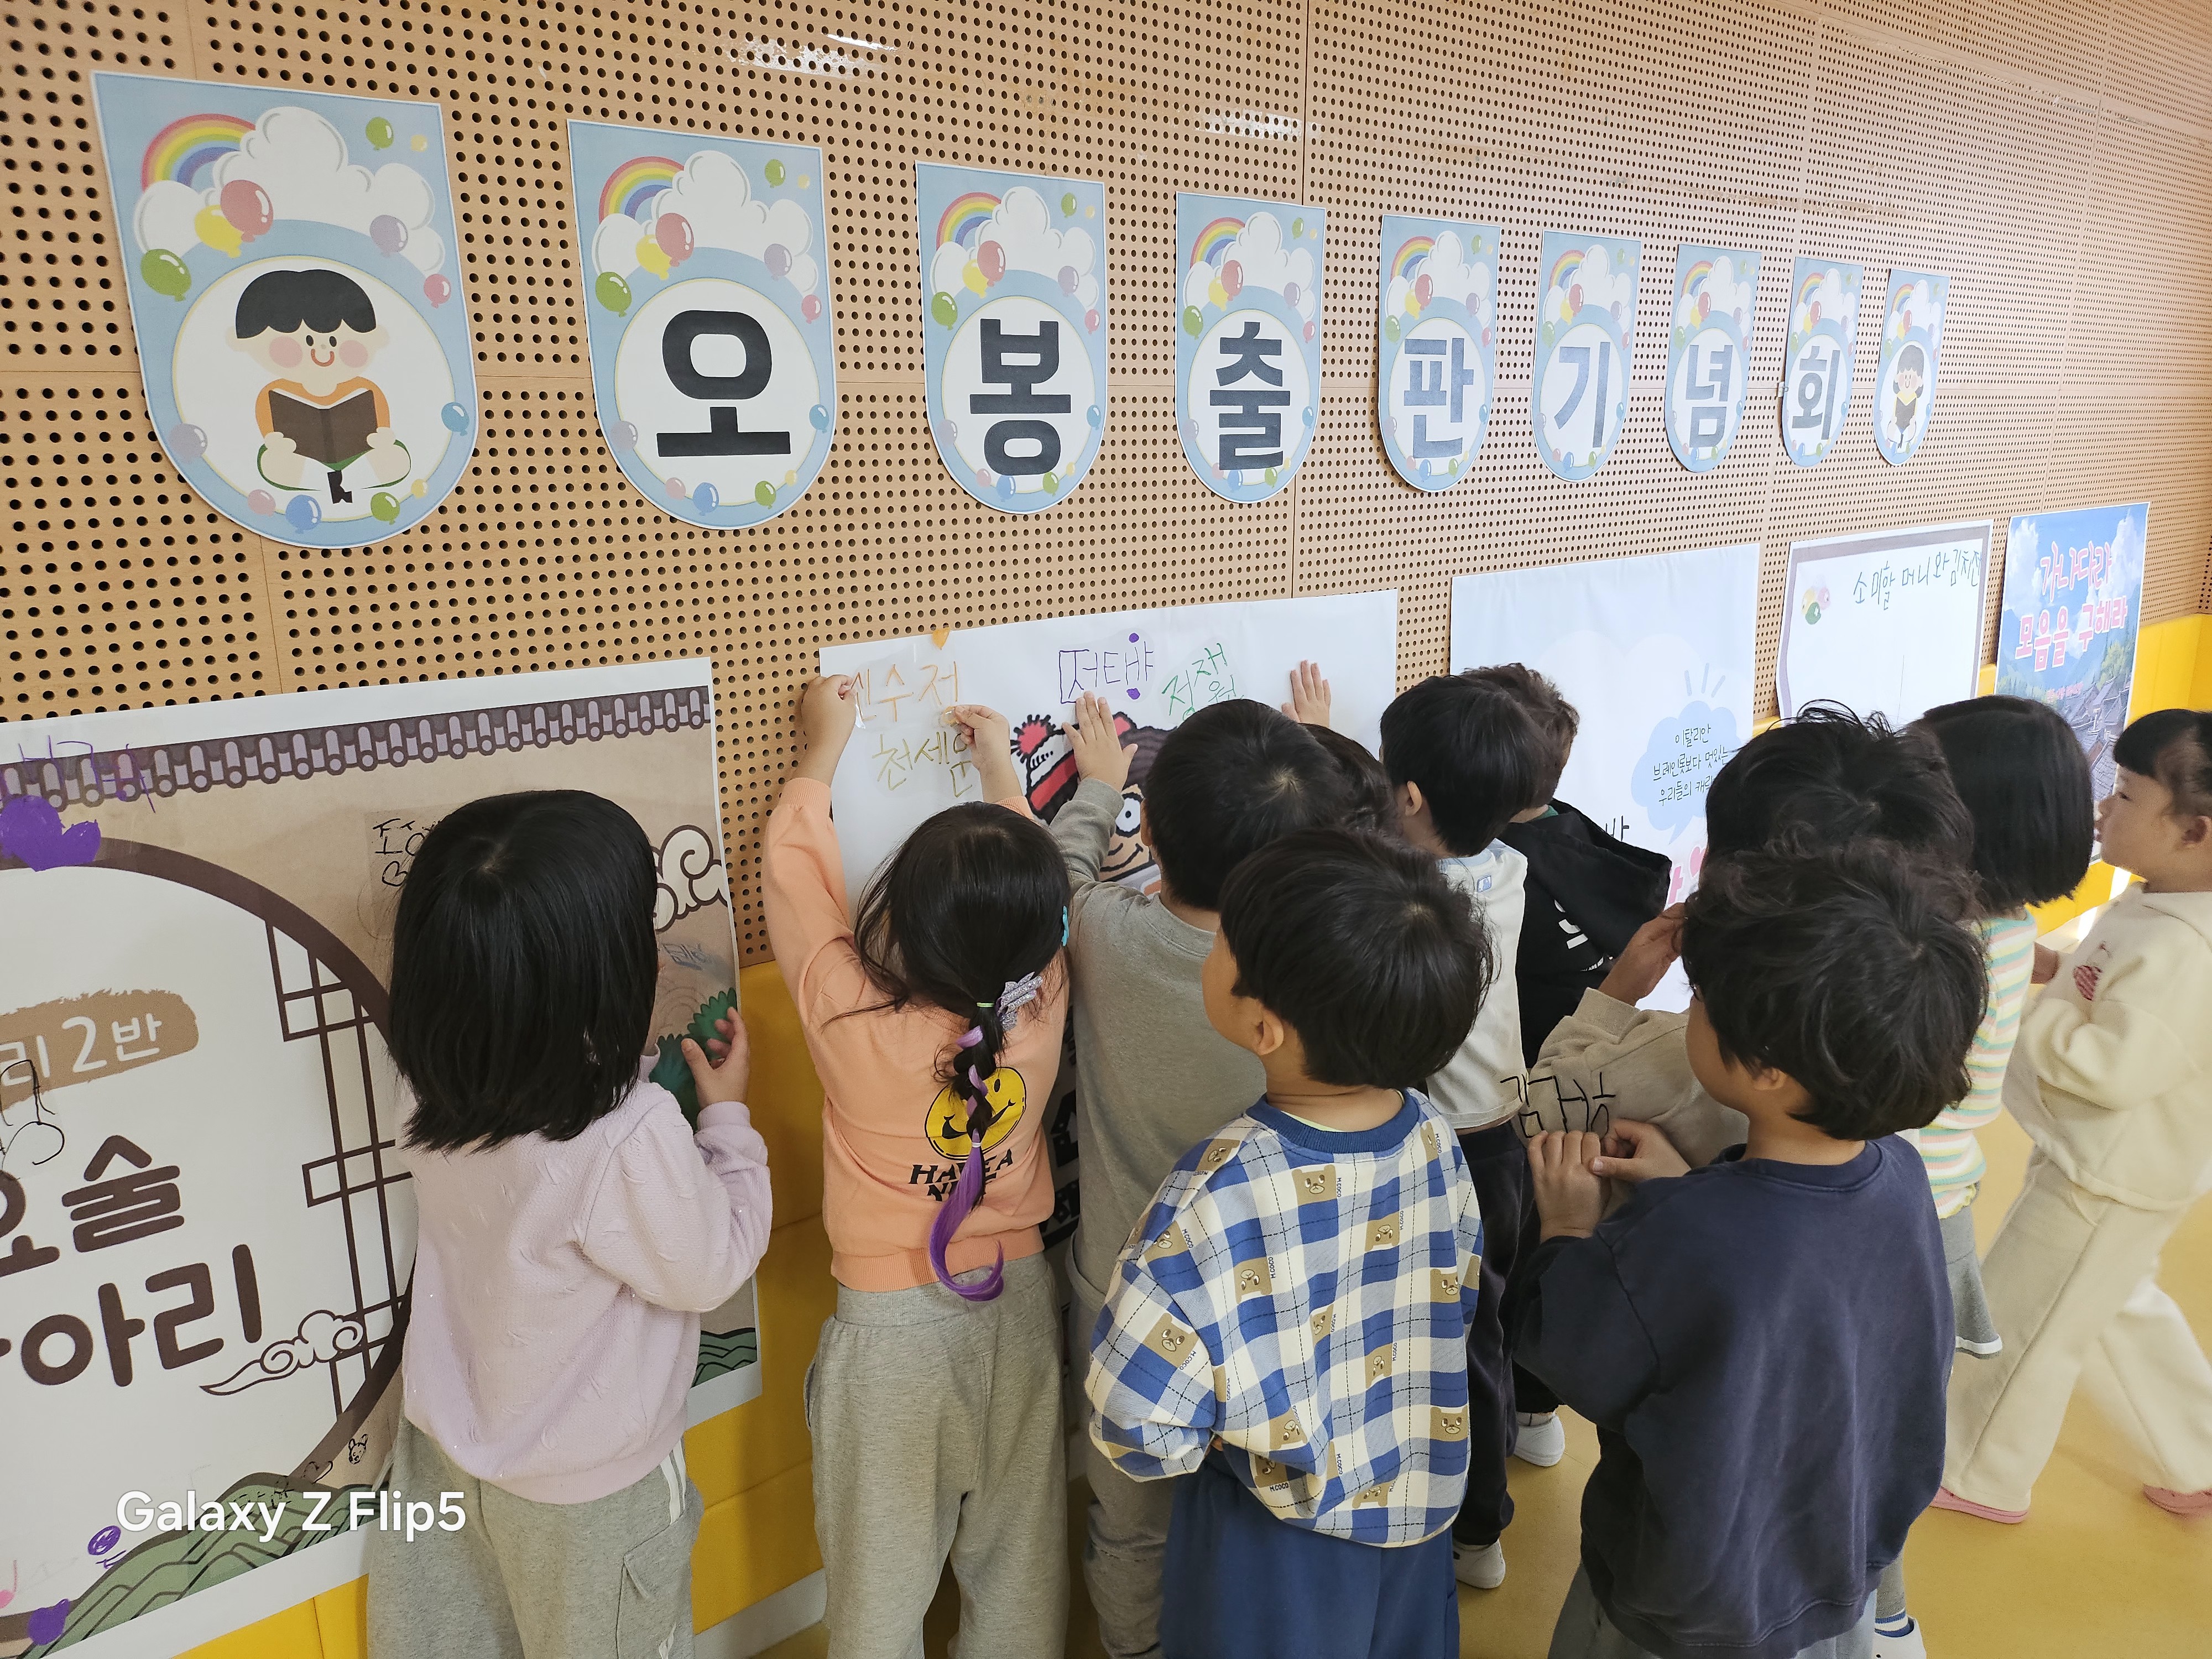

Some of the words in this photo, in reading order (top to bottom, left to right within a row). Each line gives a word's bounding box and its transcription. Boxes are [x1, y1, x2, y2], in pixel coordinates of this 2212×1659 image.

[656, 309, 791, 457] 오
[969, 318, 1072, 476] 봉
[1209, 321, 1291, 471] 출
[1404, 338, 1474, 460] 판
[1553, 341, 1611, 448] 기
[1684, 344, 1734, 448] 념
[1791, 349, 1840, 441] 회
[2015, 606, 2070, 672] 모음을
[2079, 596, 2127, 652] 구해라
[1653, 753, 1702, 781] 브레인롯보다
[1705, 744, 1728, 768] 멋있는
[1675, 723, 1712, 748] 이탈리안
[1659, 780, 1692, 806] 우리들의
[62, 1016, 107, 1073] 2
[112, 1013, 162, 1061] 반
[0, 1244, 262, 1387] 아리
